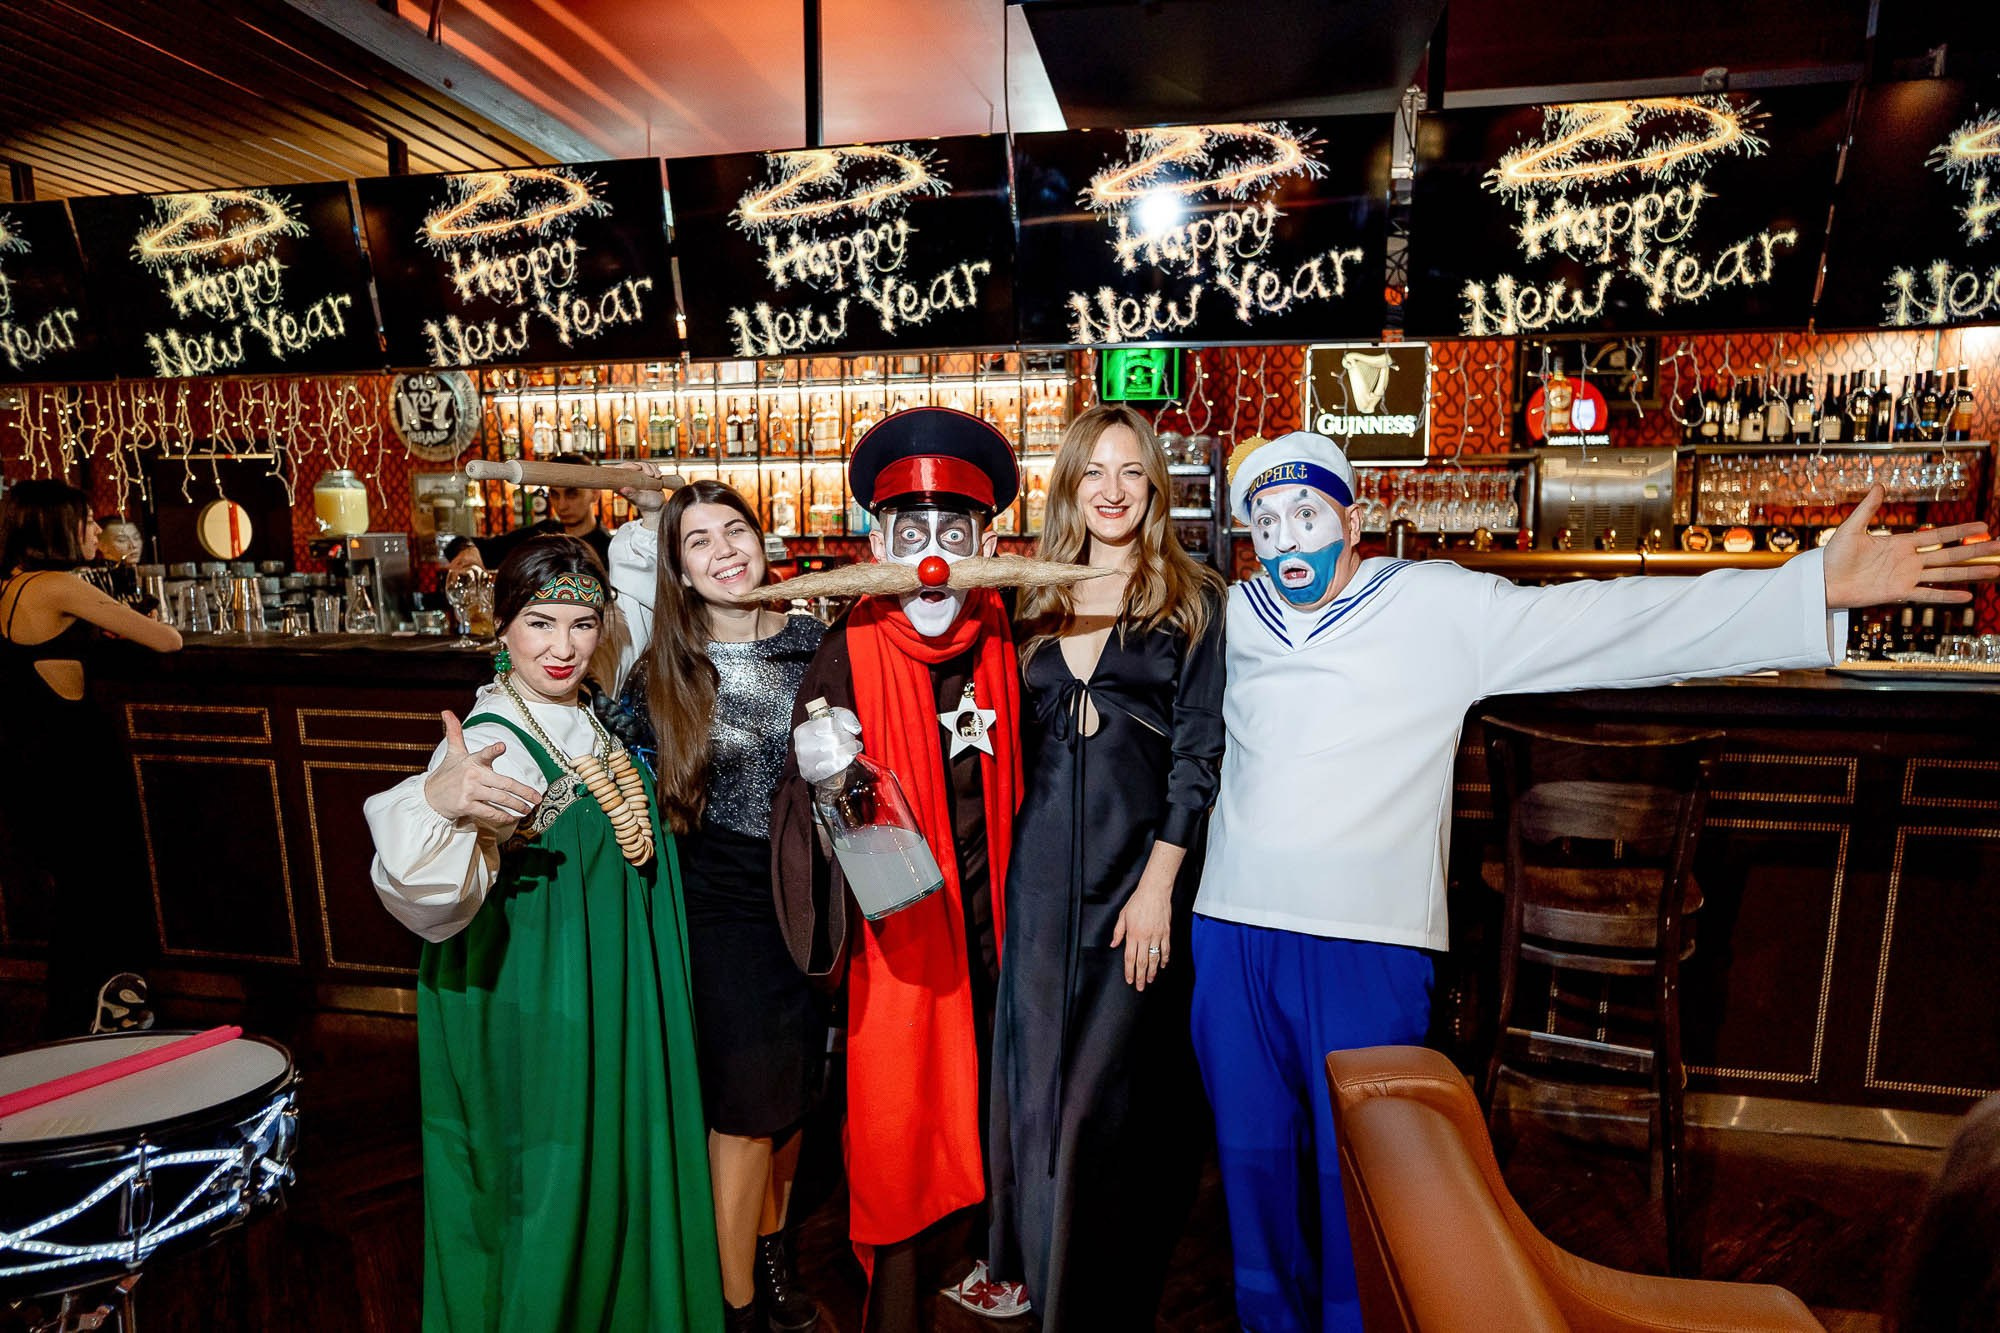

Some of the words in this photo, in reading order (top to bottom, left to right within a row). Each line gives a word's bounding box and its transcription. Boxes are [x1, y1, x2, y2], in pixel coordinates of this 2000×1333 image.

[762, 218, 912, 291] Happy
[1110, 200, 1279, 275] Happy
[1517, 180, 1708, 261] Happy
[164, 257, 286, 319] Happy
[448, 237, 581, 306] Happy
[729, 298, 849, 356] New
[855, 259, 990, 334] Year
[1067, 284, 1202, 343] New
[1210, 246, 1364, 322] Year
[1461, 272, 1612, 335] New
[1622, 229, 1798, 310] Year
[1884, 261, 2000, 325] Ne
[147, 327, 244, 377] New
[247, 295, 352, 358] Year
[424, 311, 530, 367] New
[535, 276, 654, 346] Year
[408, 374, 436, 390] OLD
[408, 430, 449, 445] BRAND
[1316, 413, 1417, 436] GUINNESS
